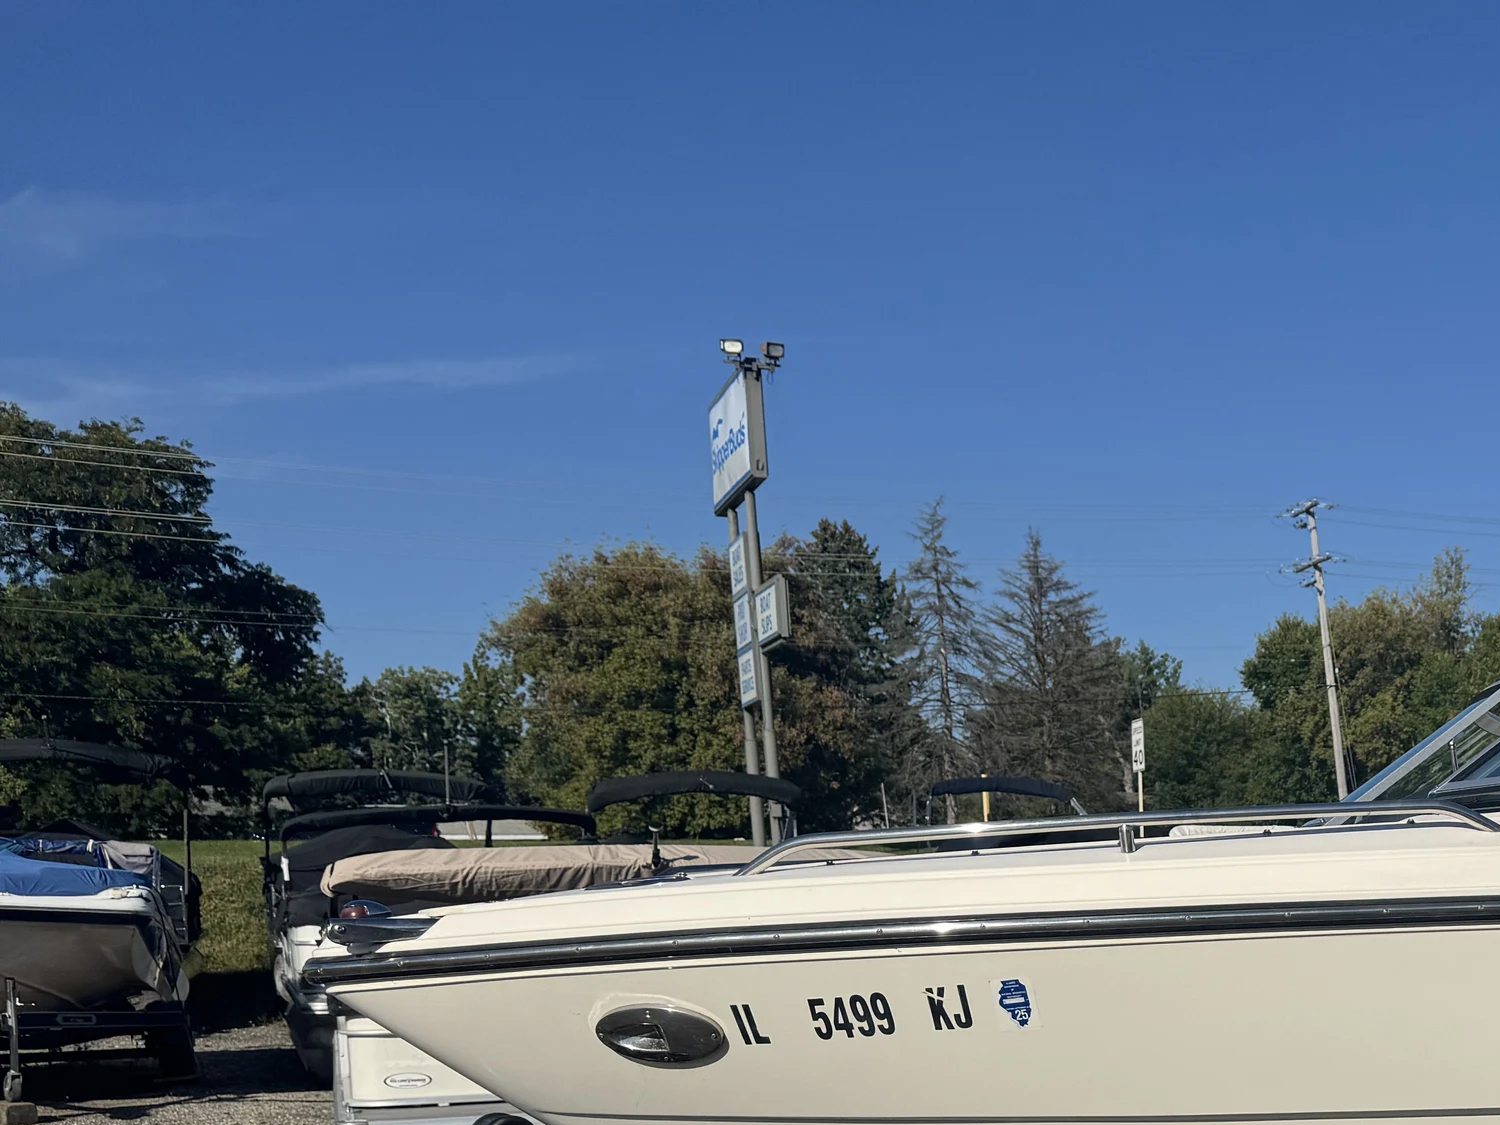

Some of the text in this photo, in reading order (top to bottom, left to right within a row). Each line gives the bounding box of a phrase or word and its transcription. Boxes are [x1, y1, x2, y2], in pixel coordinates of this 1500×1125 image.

[759, 592, 771, 614] BOAT
[1134, 749, 1143, 765] 40
[729, 984, 974, 1046] IL 5499 KJ
[1014, 1008, 1029, 1020] 25
